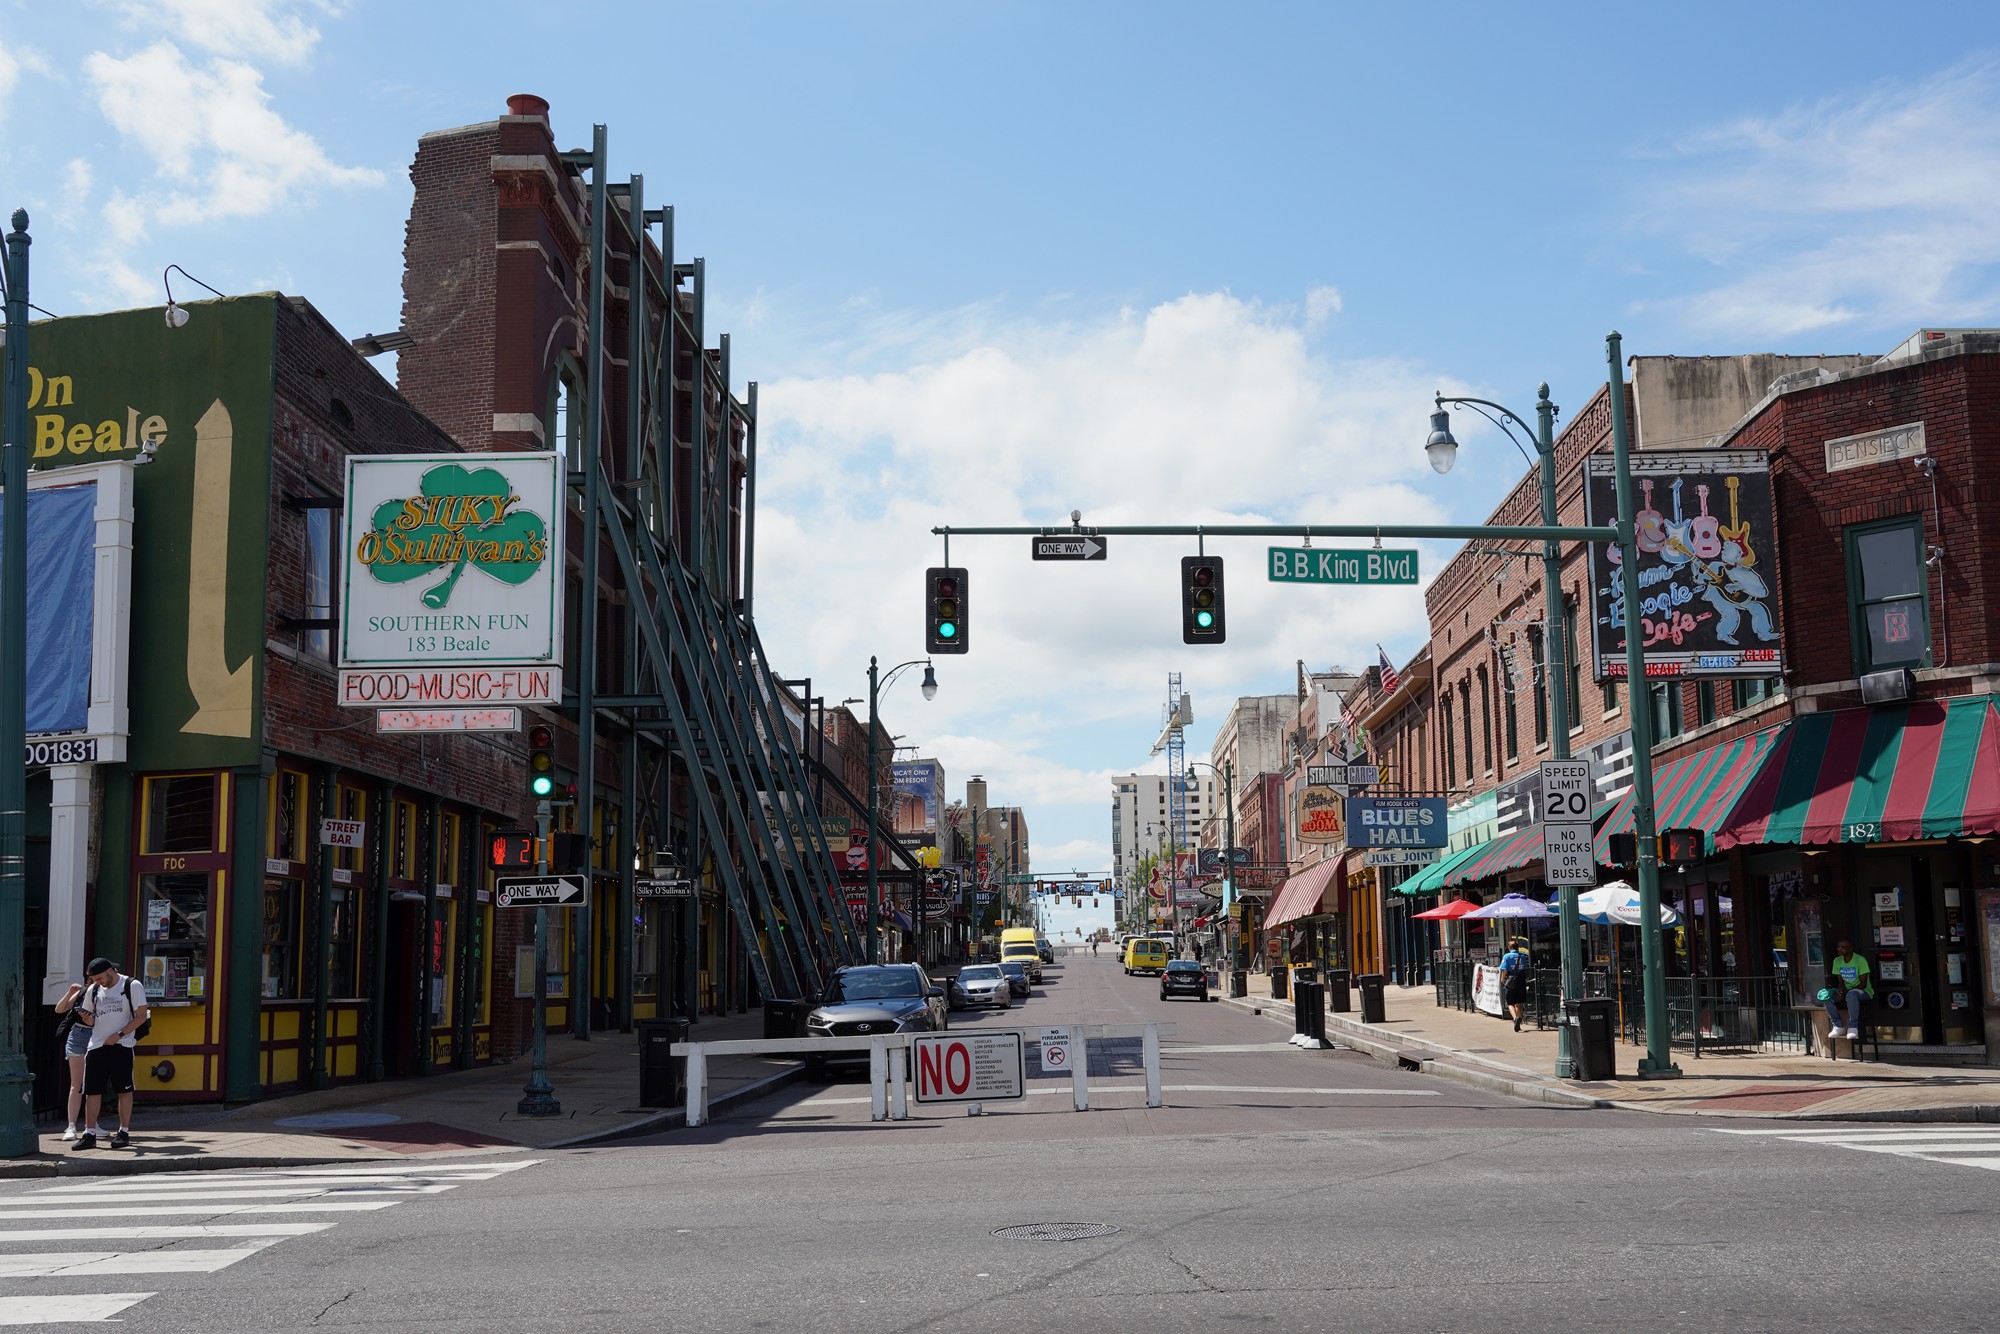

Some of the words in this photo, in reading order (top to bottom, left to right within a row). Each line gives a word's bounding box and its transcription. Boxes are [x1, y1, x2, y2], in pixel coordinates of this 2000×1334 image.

[33, 405, 168, 458] Beale
[1833, 430, 1916, 464] BENSIECK
[395, 495, 521, 532] SILKY
[357, 525, 545, 565] O'Sullivan's
[1041, 544, 1061, 553] ONE
[1065, 544, 1086, 553] WAY
[1273, 552, 1315, 577] B.B.
[1319, 553, 1359, 582] King
[1367, 554, 1415, 579] Blvd.
[1609, 582, 1693, 629] Bogie
[368, 615, 481, 632] SOUTHERN
[488, 614, 529, 630] FUN
[408, 636, 436, 651] 183
[443, 635, 490, 651] Beale
[1608, 663, 1683, 676] RESURANT
[1700, 655, 1736, 668] BLUES
[1745, 649, 1775, 661] CLUB
[1309, 767, 1346, 784] STRANGE
[1349, 767, 1378, 783] CARGO
[1545, 768, 1586, 777] SPEED
[1550, 780, 1581, 790] LIMIT
[1547, 793, 1586, 815] 20
[1311, 810, 1335, 820] TAP
[1362, 808, 1434, 826] BLUES
[325, 821, 361, 834] STREET
[1302, 819, 1339, 832] ROOM
[1849, 824, 1876, 838] 182
[330, 834, 352, 845] BAR
[1369, 828, 1425, 844] HALL
[1561, 831, 1576, 840] NO
[519, 839, 531, 863] 2
[1548, 843, 1591, 853] TRUCKS
[1688, 835, 1697, 858] 2
[164, 858, 186, 870] FDC
[1370, 854, 1396, 864] JUKE
[1403, 852, 1433, 863] JOINT
[1563, 857, 1577, 865] OR
[1552, 869, 1589, 878] BUSES
[1239, 878, 1273, 888] CAFE
[508, 886, 531, 898] ONE
[536, 885, 559, 897] WAY
[637, 886, 653, 897] Silky
[655, 885, 690, 895] O'Sullivan's
[920, 1042, 971, 1096] NO
